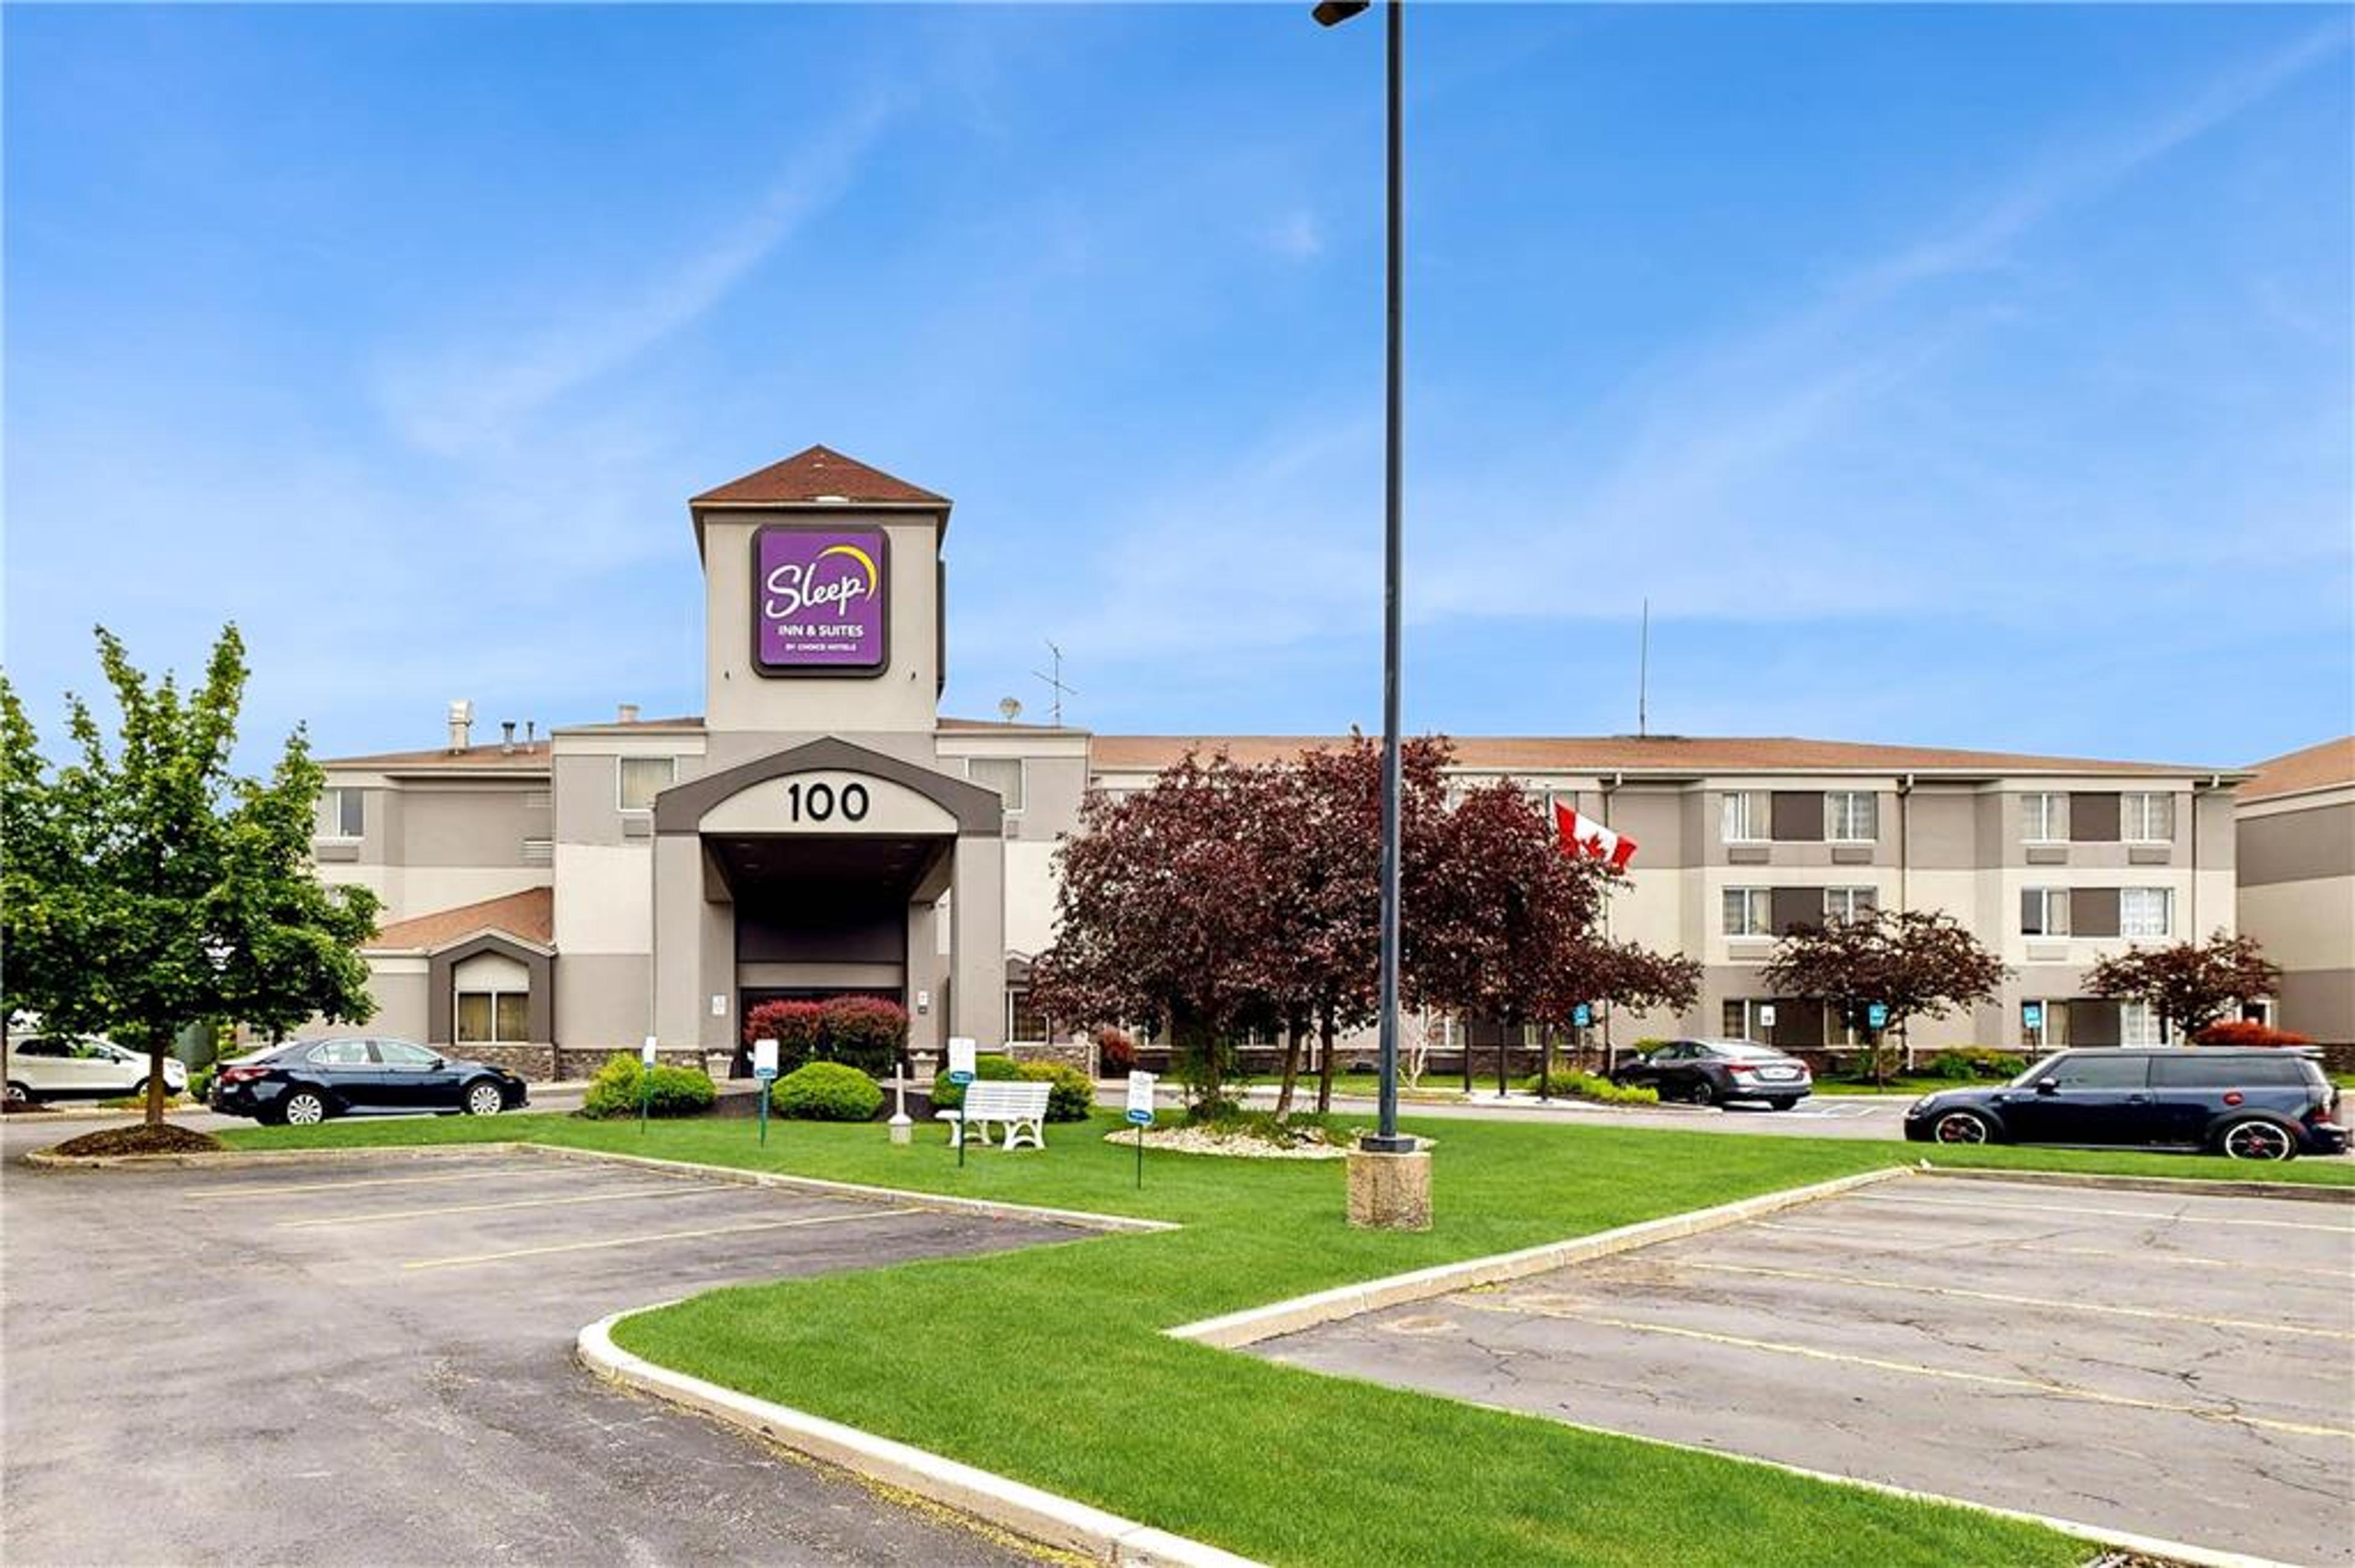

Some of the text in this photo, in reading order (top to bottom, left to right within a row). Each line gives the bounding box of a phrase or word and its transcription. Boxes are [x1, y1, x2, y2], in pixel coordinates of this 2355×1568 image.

[765, 562, 865, 619] Sleep
[778, 625, 864, 637] INN & SUITES
[788, 782, 869, 822] 100
